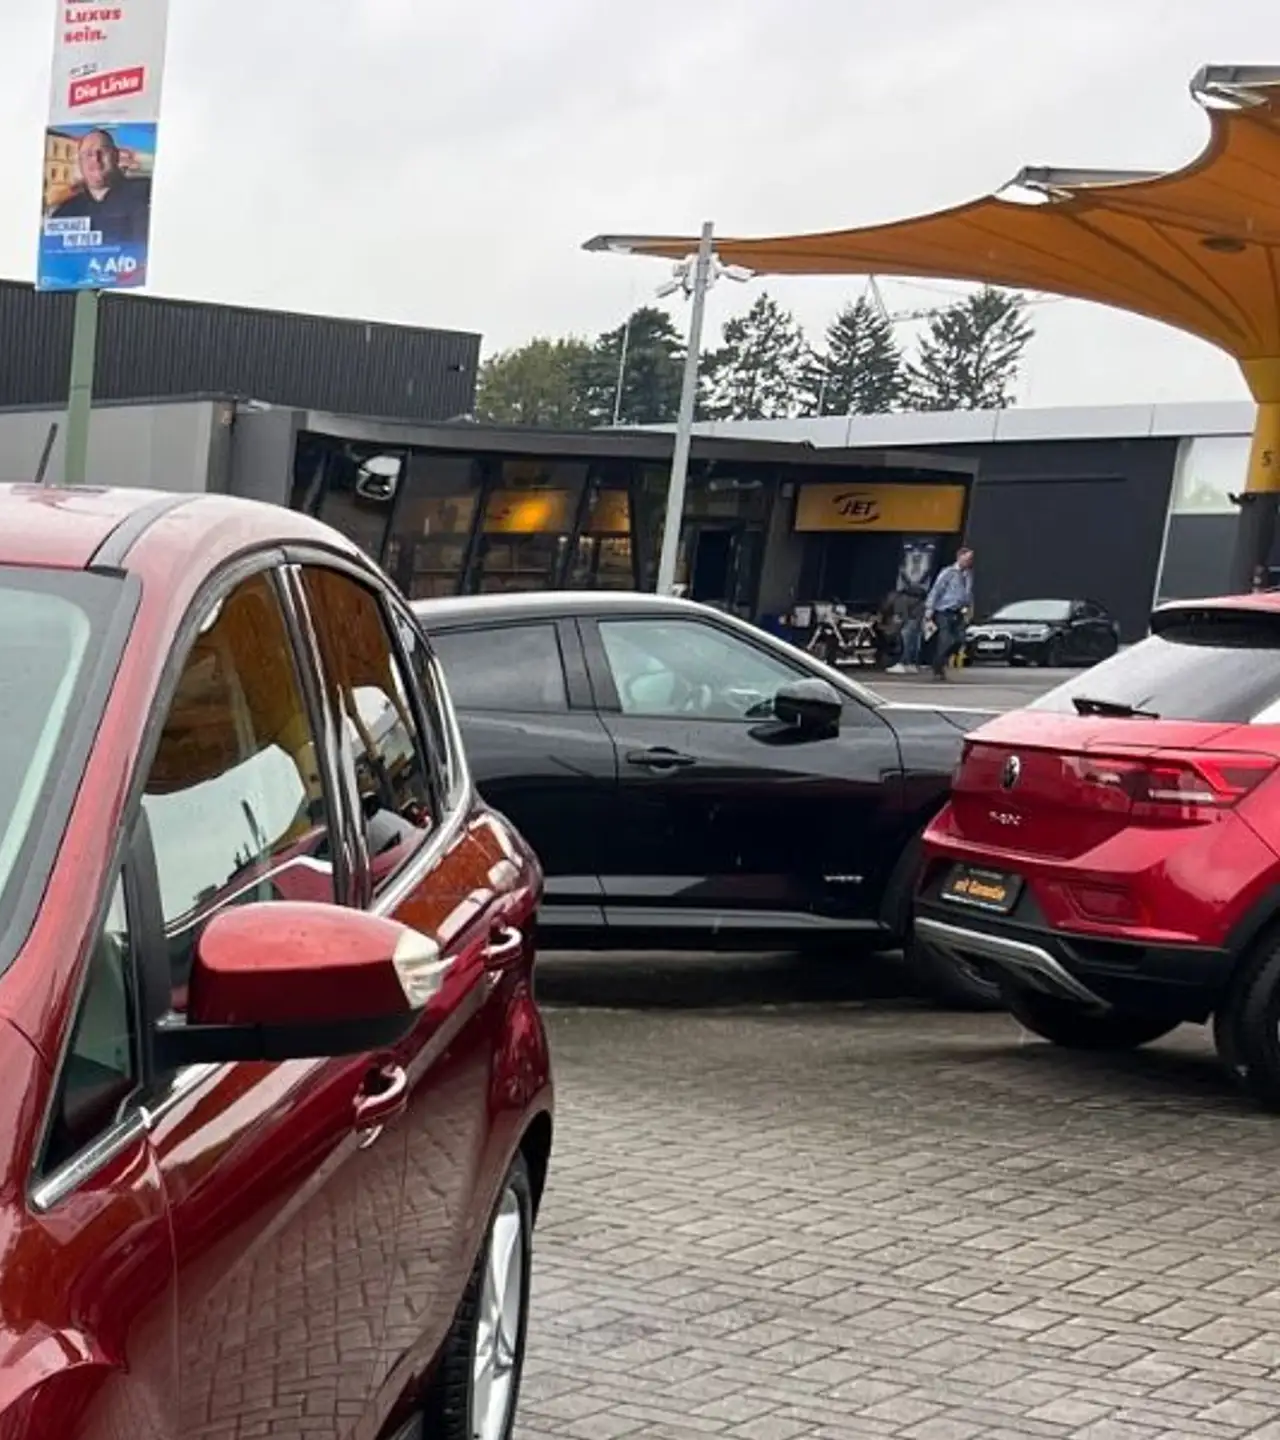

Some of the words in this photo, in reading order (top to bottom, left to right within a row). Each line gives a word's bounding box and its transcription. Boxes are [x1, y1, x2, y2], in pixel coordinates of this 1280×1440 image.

[65, 7, 122, 24] Luxus
[64, 26, 108, 44] sein.
[75, 83, 98, 102] Die
[101, 75, 139, 94] Linke
[104, 255, 137, 273] AfD
[839, 500, 878, 517] JET
